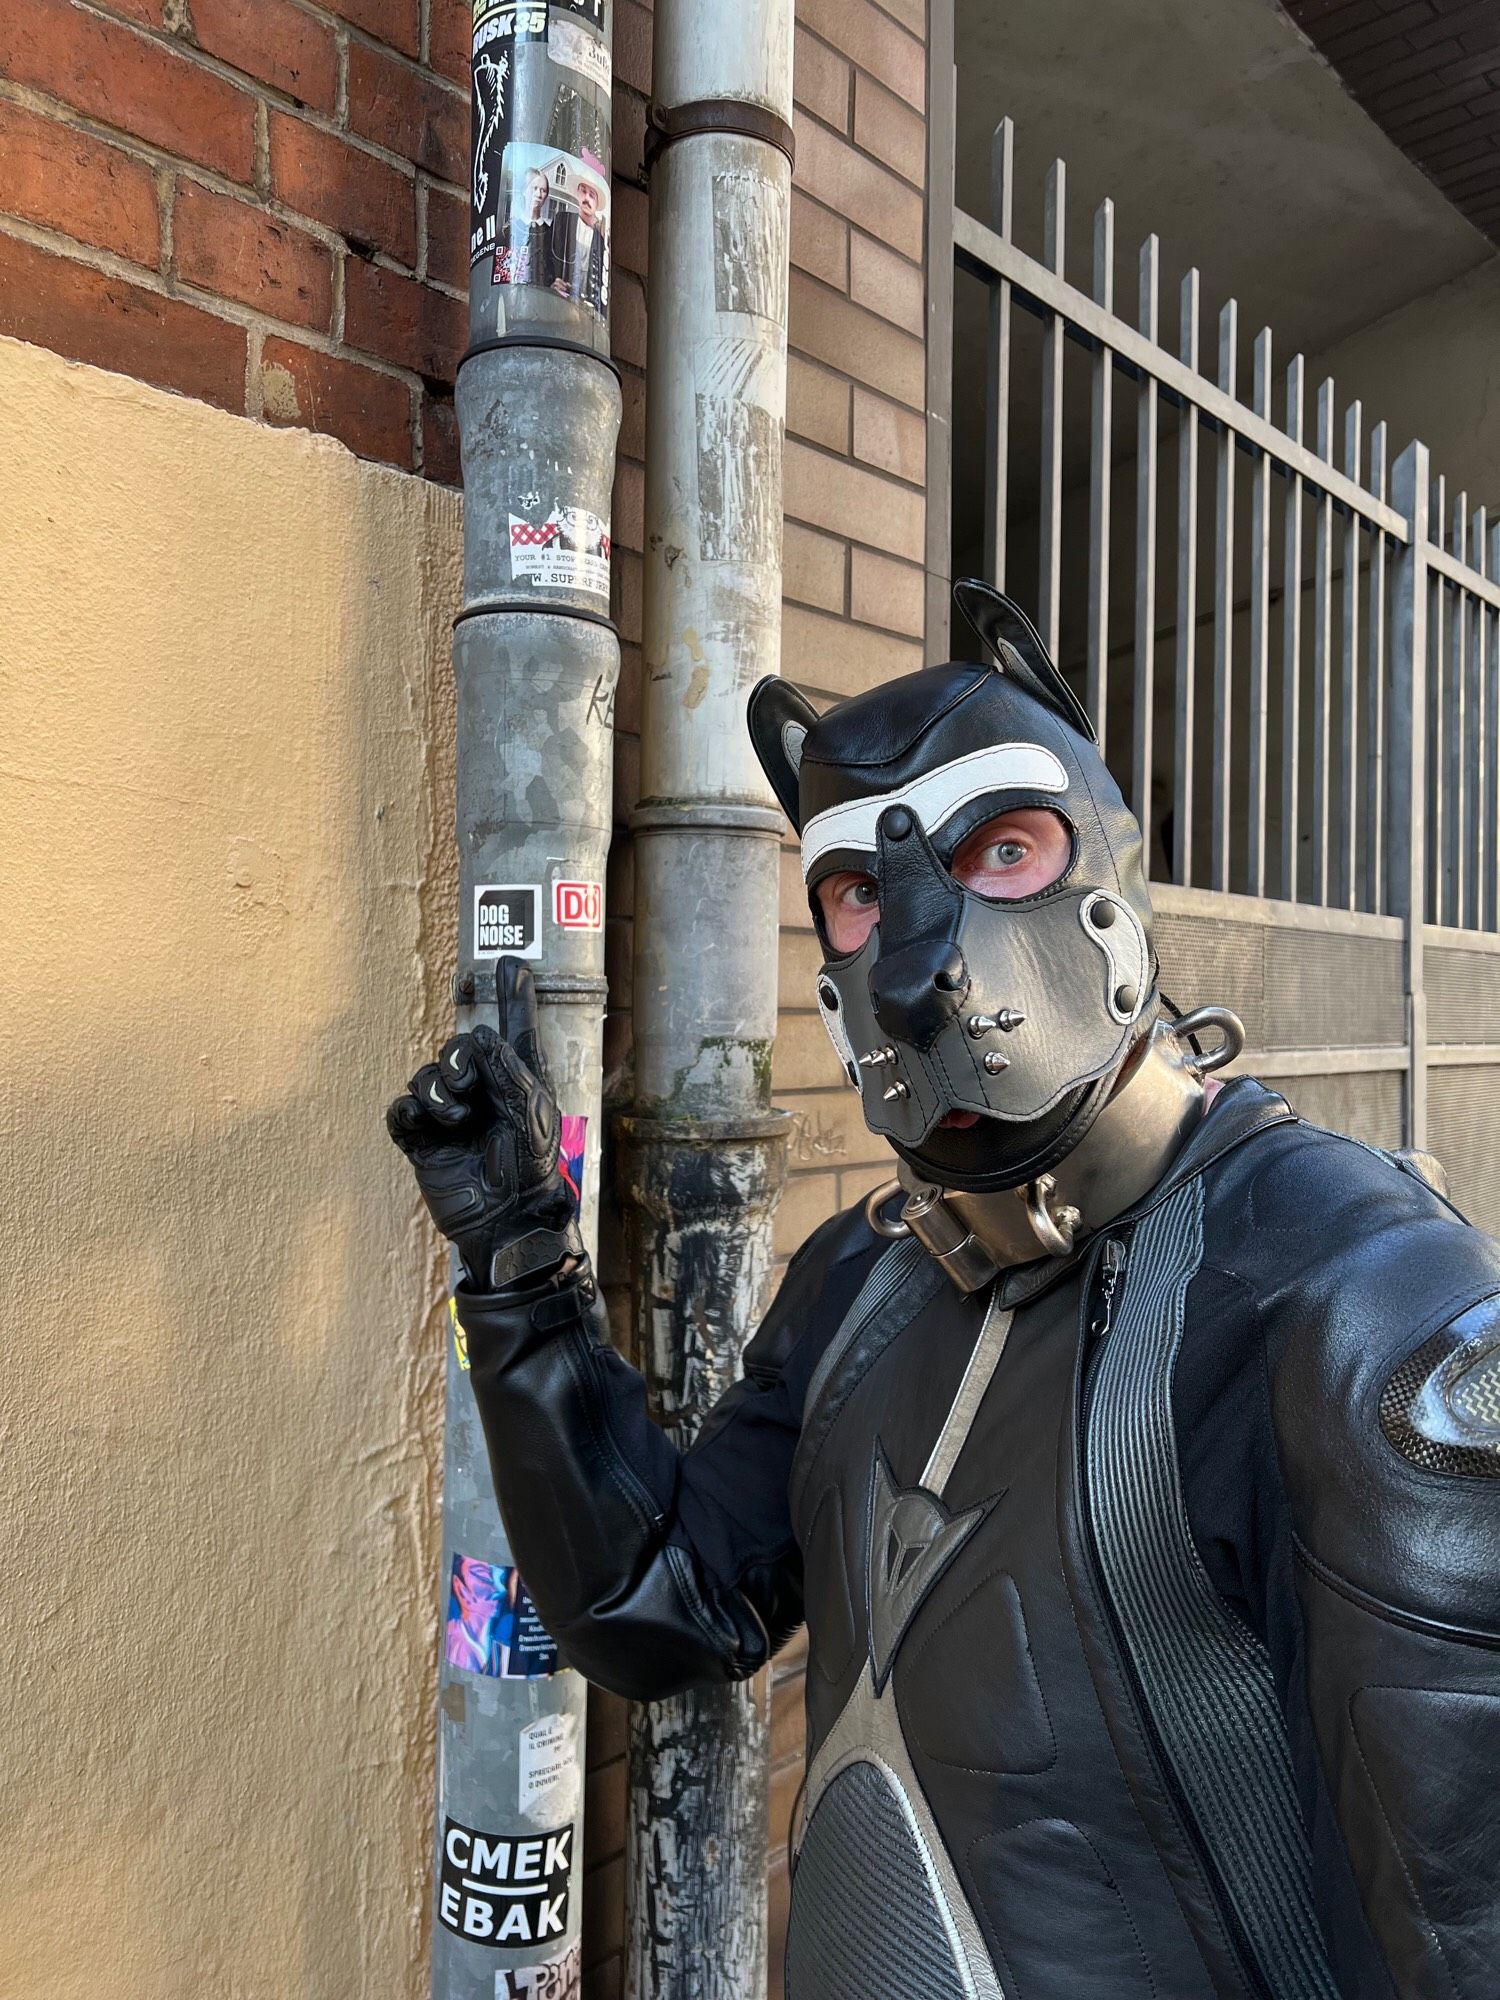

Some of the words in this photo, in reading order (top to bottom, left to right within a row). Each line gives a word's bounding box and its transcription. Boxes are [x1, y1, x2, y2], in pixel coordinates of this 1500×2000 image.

[515, 554, 537, 562] YOUR
[480, 905, 509, 925] DOG
[480, 925, 524, 946] NOISE
[446, 1829, 571, 1880] CMEK
[441, 1882, 566, 1941] EBAK
